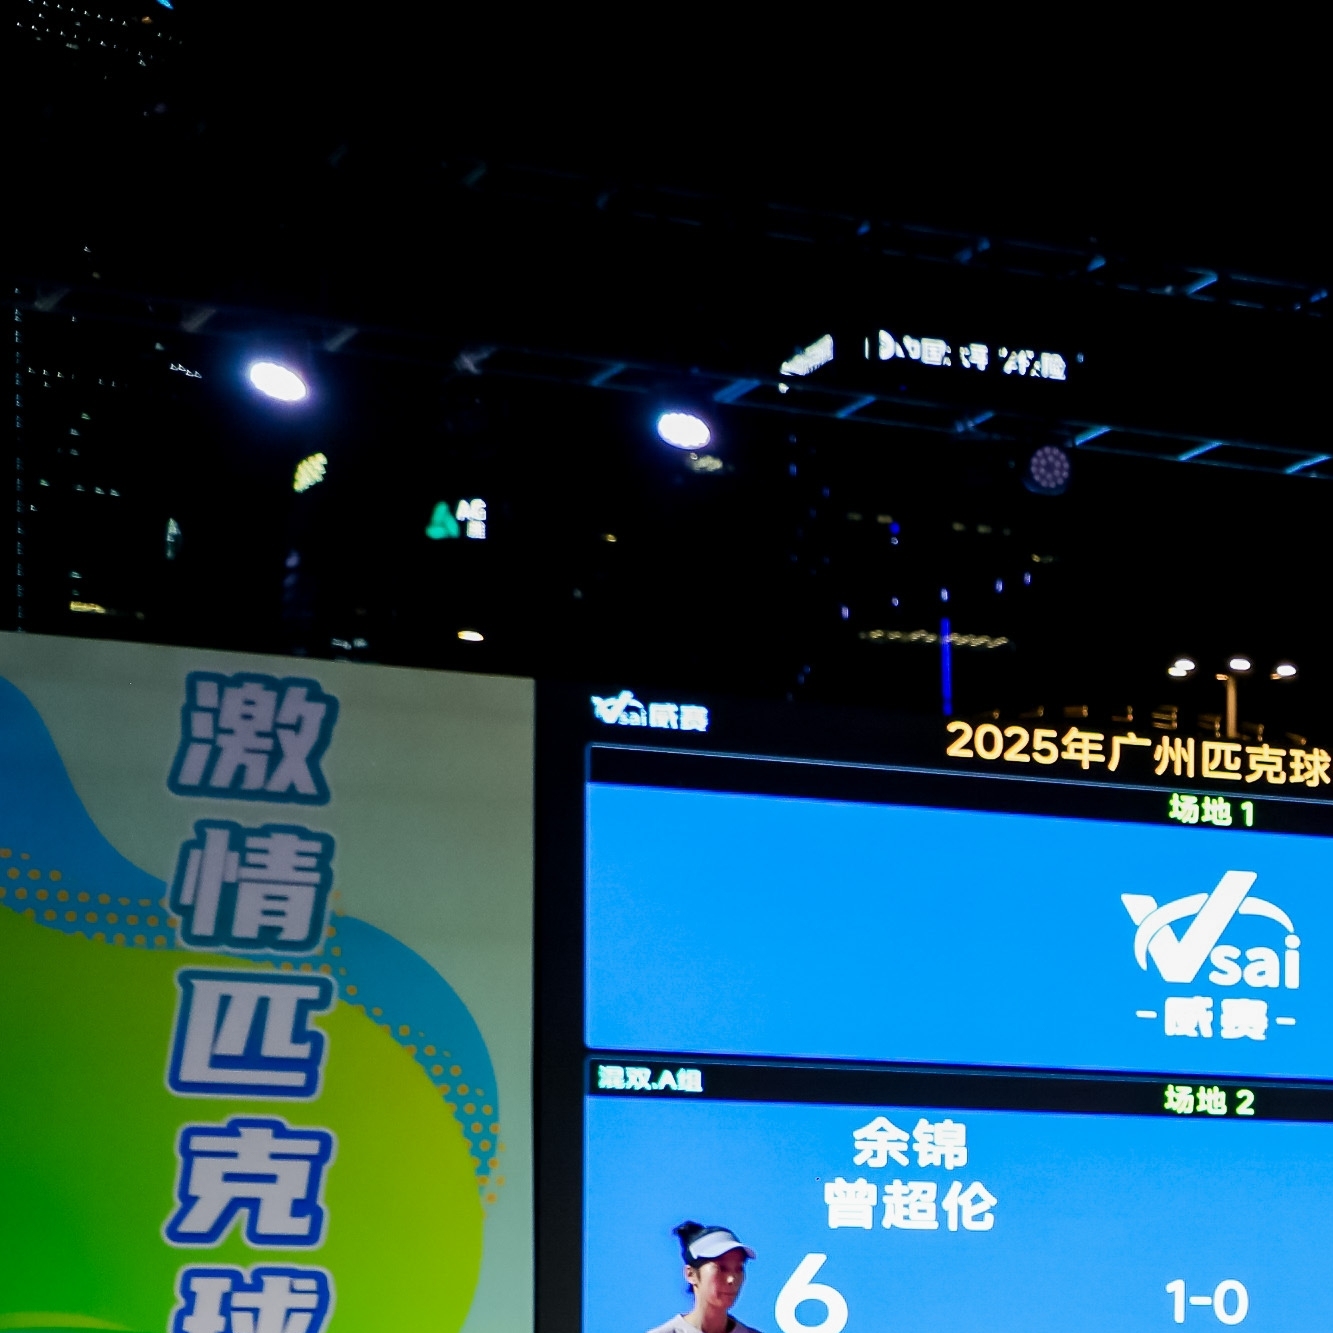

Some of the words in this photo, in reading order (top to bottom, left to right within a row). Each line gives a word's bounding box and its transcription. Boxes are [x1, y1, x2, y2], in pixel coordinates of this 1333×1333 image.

[1169, 793, 1232, 825] 场地
[1242, 800, 1254, 826] 1
[1164, 1084, 1228, 1114] 场地
[1236, 1089, 1255, 1116] 2
[852, 1116, 968, 1170] 余锦
[824, 1177, 997, 1232] 曾超伦
[1165, 1278, 1249, 1326] 1-0
